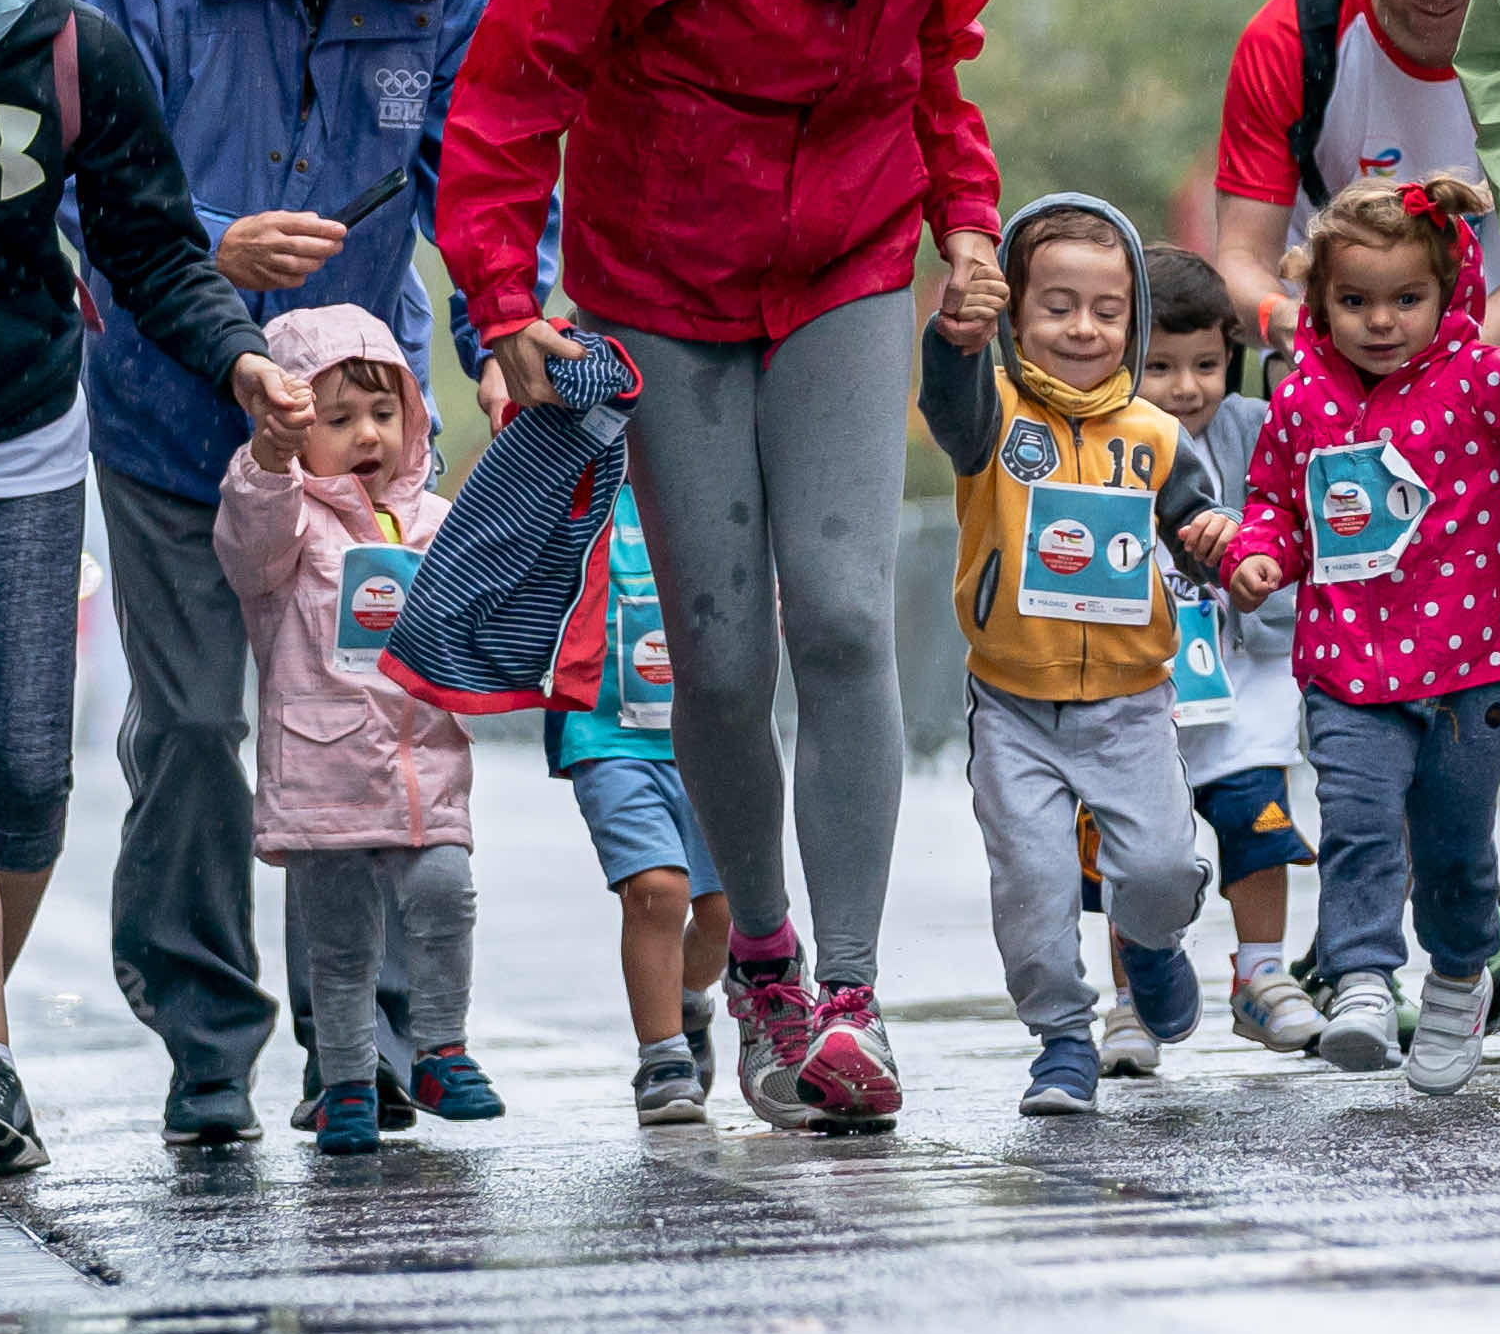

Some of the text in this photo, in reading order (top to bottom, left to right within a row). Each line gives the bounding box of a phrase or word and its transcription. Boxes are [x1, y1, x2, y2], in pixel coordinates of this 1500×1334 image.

[379, 101, 424, 121] IBM
[1103, 437, 1156, 491] 19
[1396, 485, 1410, 515] 1
[1118, 537, 1129, 567] 1
[1197, 644, 1208, 669] 1
